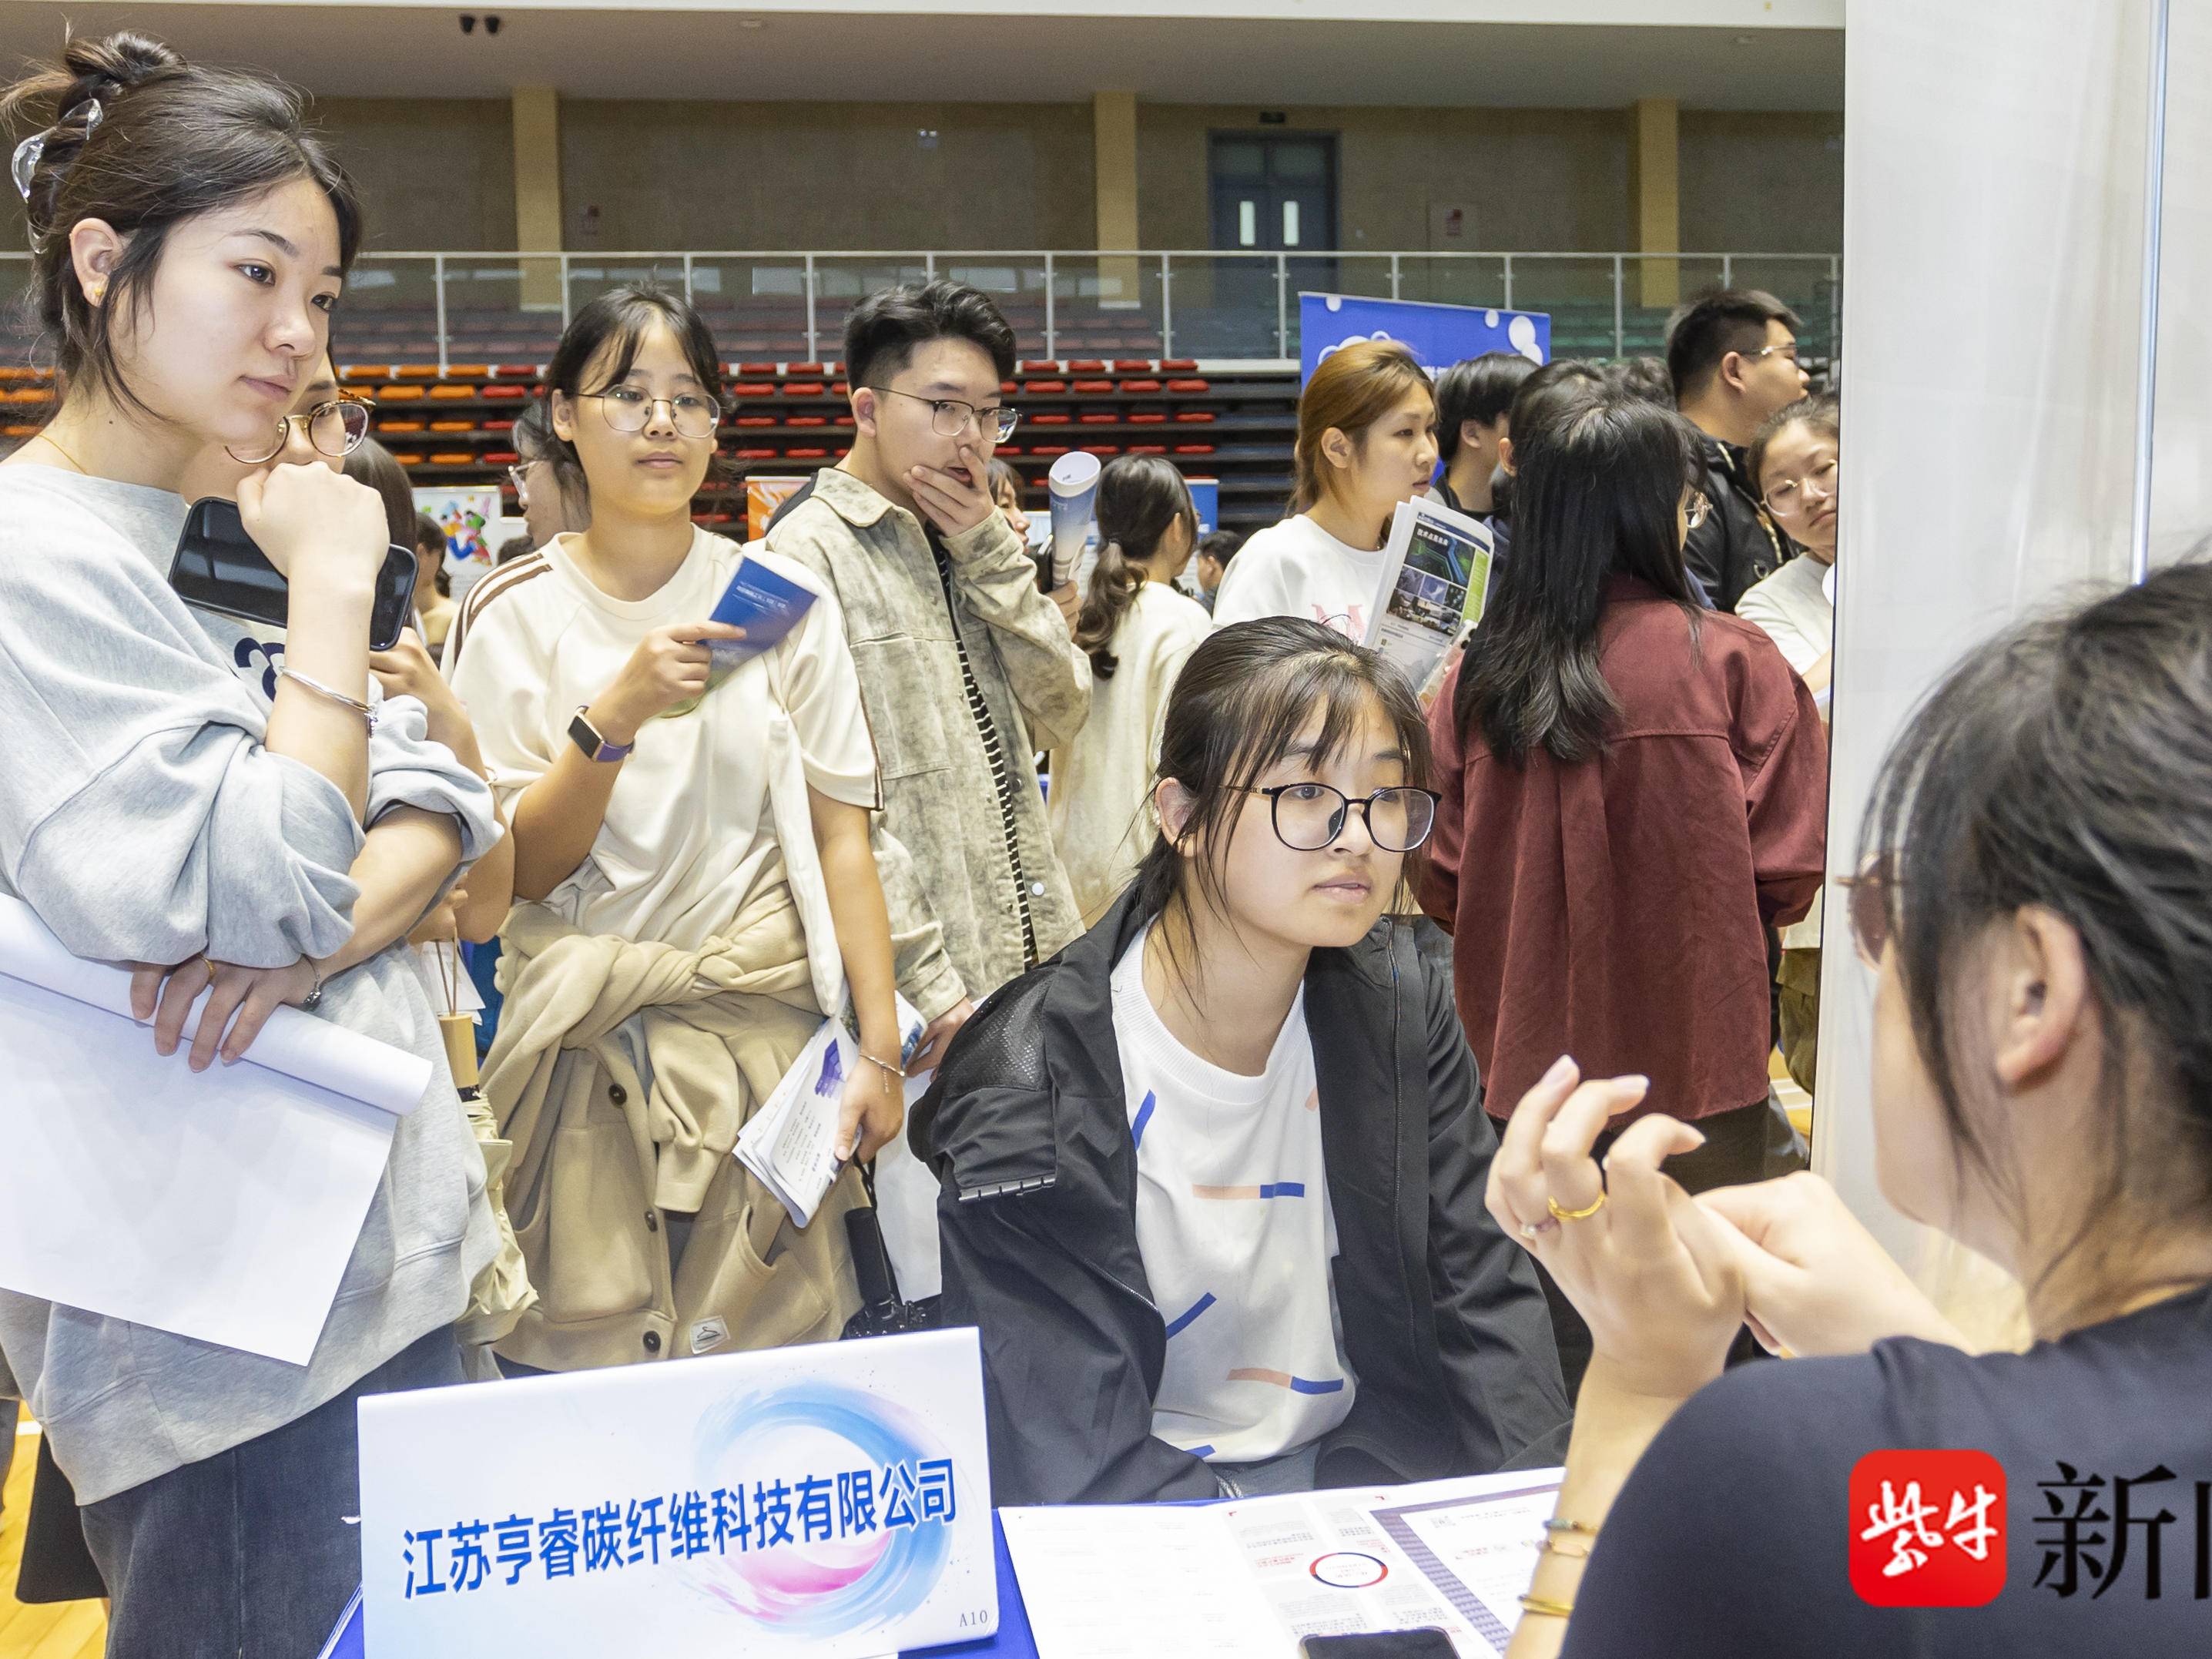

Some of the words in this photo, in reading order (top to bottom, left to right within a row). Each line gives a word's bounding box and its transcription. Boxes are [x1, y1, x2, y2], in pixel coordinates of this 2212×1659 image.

[402, 1458, 955, 1600] 江苏亨睿碳纤维科技有限公司
[960, 1610, 987, 1627] A10
